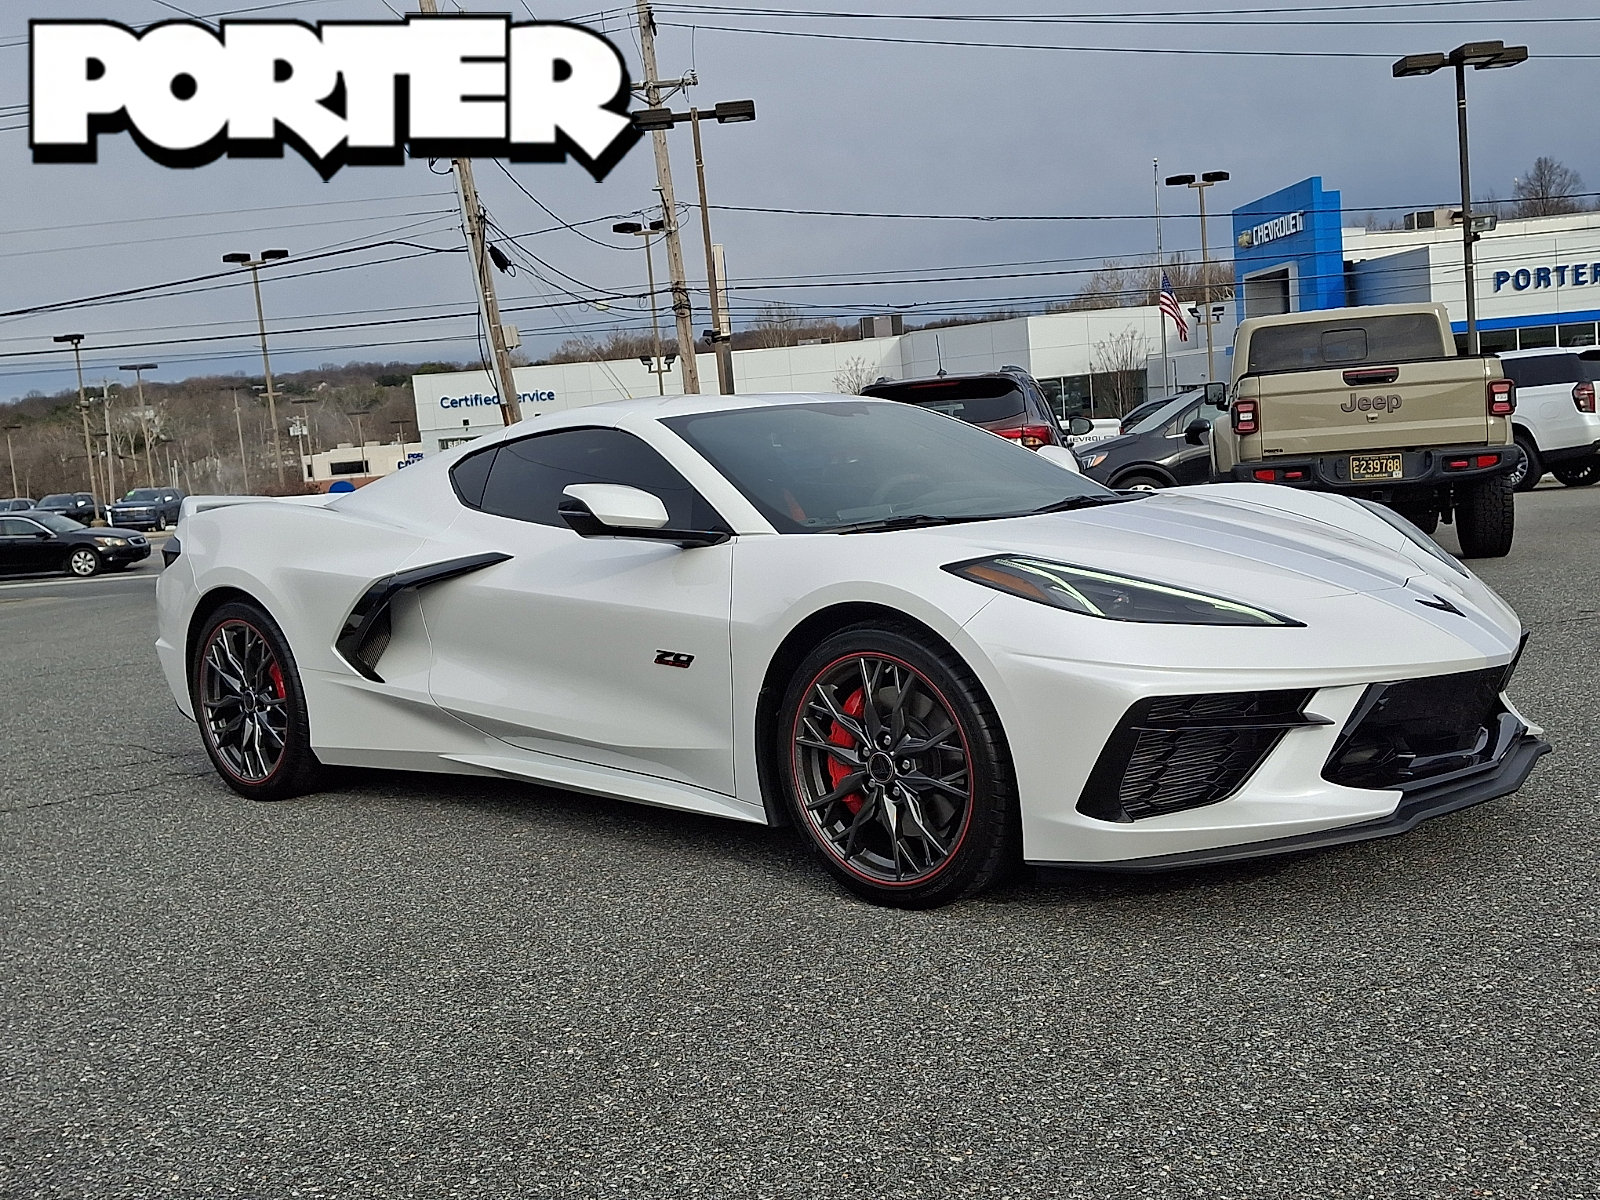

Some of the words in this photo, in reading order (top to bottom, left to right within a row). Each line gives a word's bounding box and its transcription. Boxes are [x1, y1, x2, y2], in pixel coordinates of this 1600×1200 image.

[1252, 210, 1304, 246] CHEVROLET
[440, 393, 500, 408] Certified
[515, 389, 555, 404] ervice
[1340, 393, 1402, 413] Jeep
[1360, 459, 1401, 474] 239788
